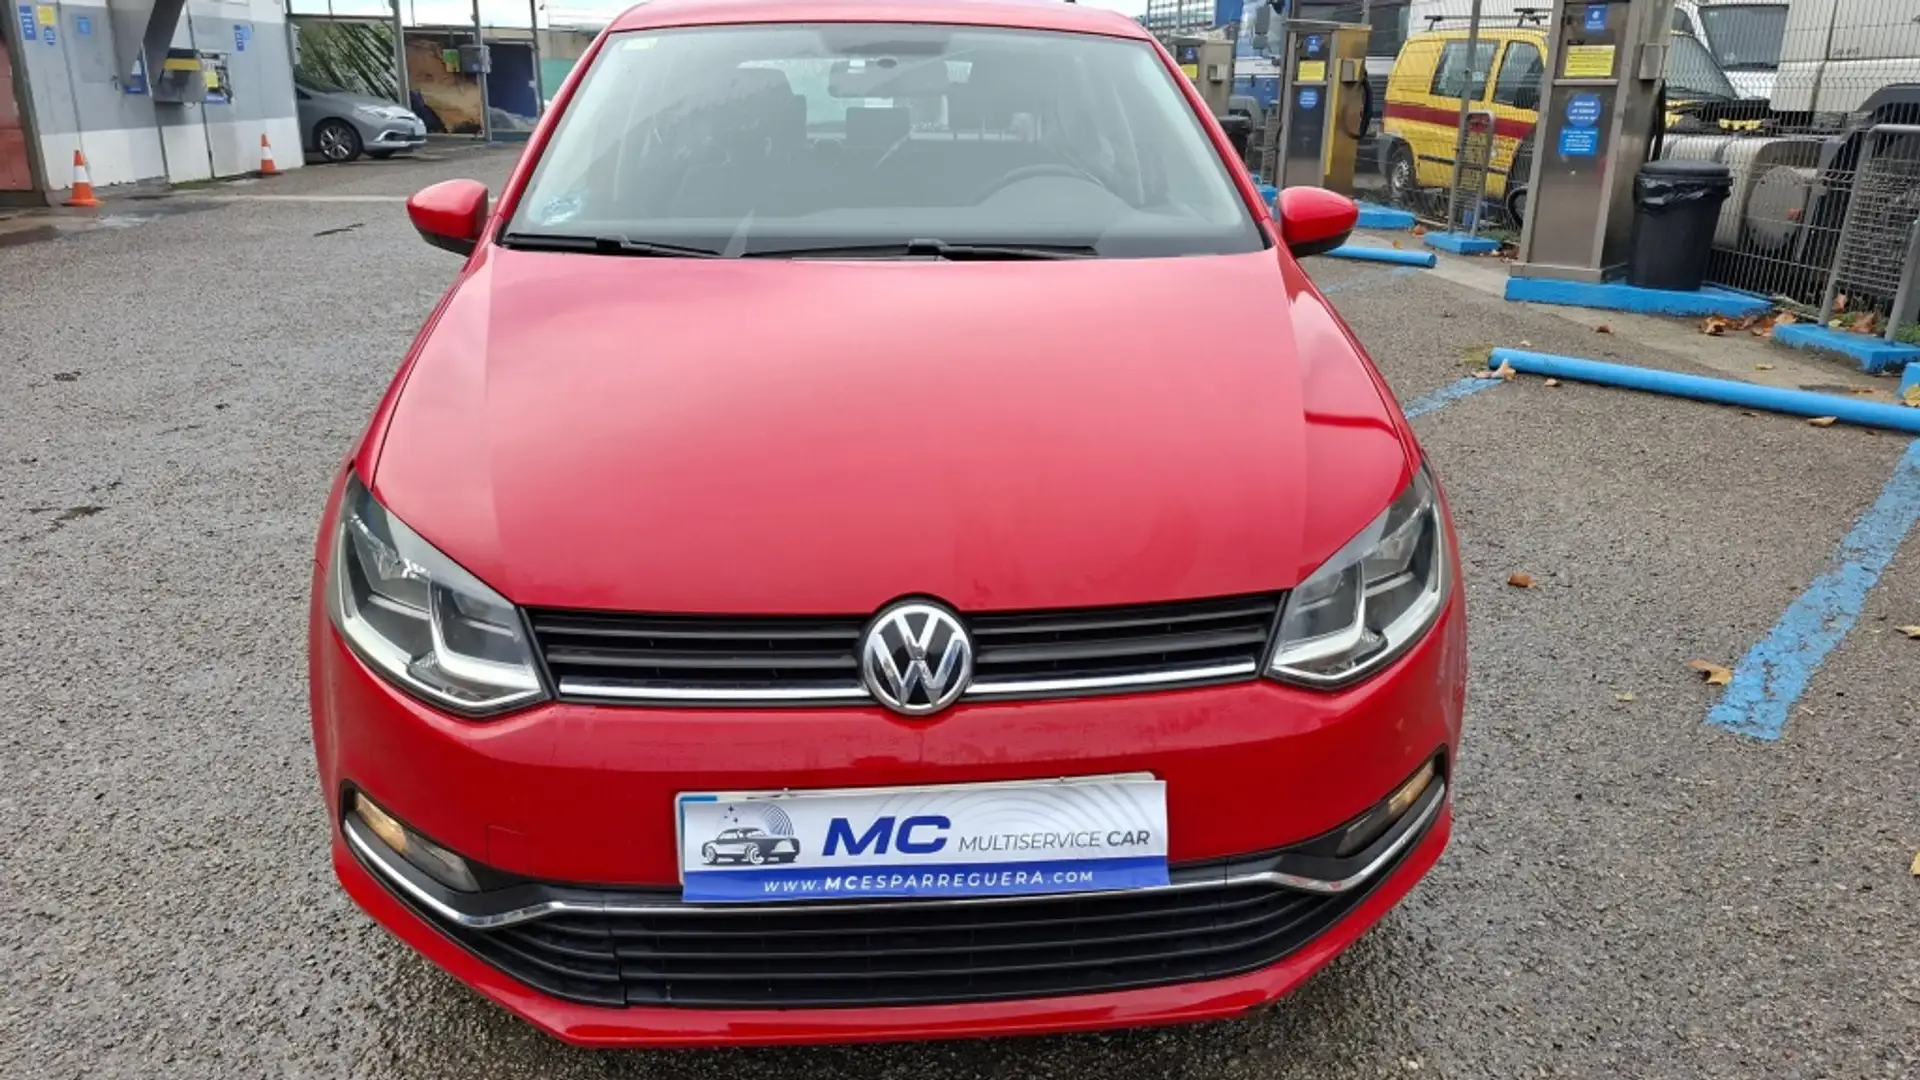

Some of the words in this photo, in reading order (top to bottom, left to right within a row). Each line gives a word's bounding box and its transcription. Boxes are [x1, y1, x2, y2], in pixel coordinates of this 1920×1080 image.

[821, 815, 951, 856] MC
[958, 830, 1101, 853] MULTISERVICE
[1106, 830, 1151, 847] CAR
